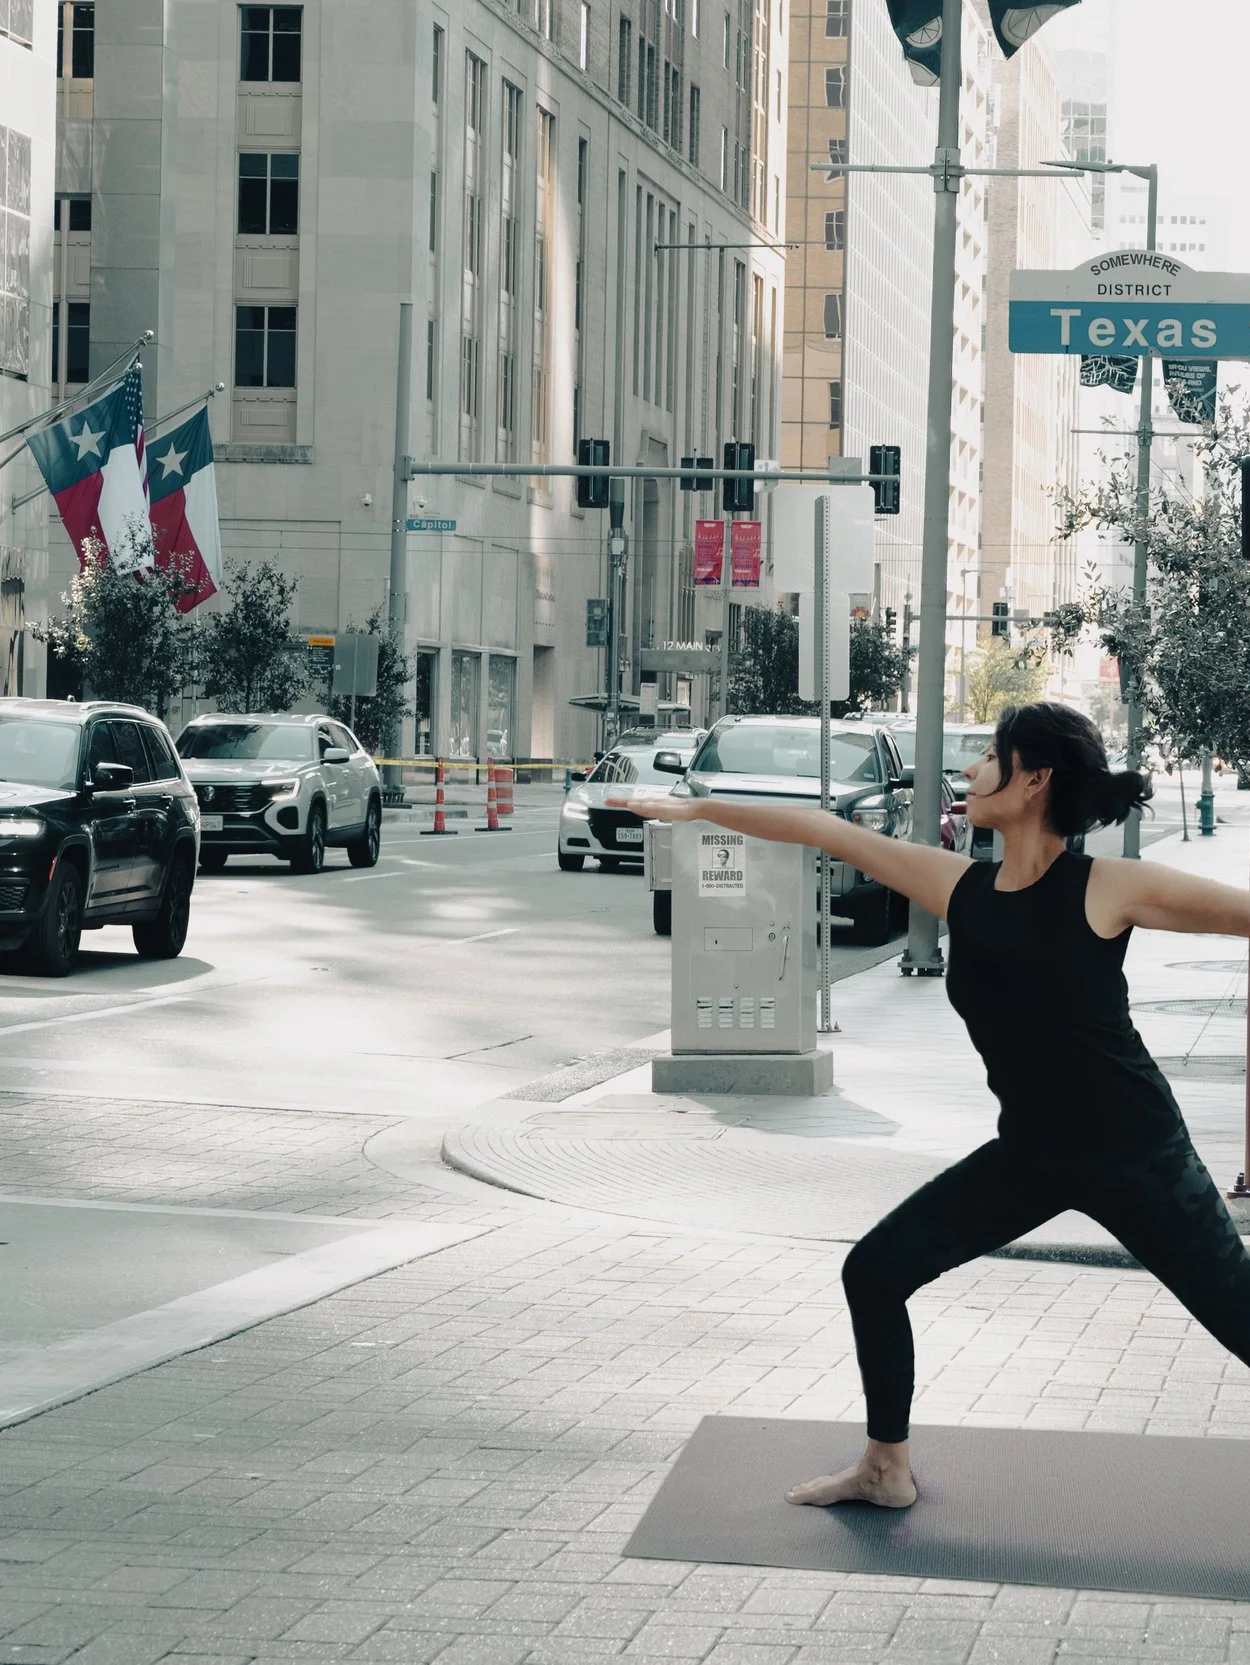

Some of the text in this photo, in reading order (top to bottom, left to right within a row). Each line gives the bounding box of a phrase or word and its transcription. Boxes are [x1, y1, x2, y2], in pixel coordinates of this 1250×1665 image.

[1090, 253, 1181, 277] SOMEWHERE
[1097, 283, 1172, 296] DISTRICT
[1050, 308, 1217, 348] Texas
[413, 520, 452, 530] Capitol
[676, 641, 703, 651] MAIN
[701, 834, 744, 846] MISSING
[702, 870, 743, 881] REWARD
